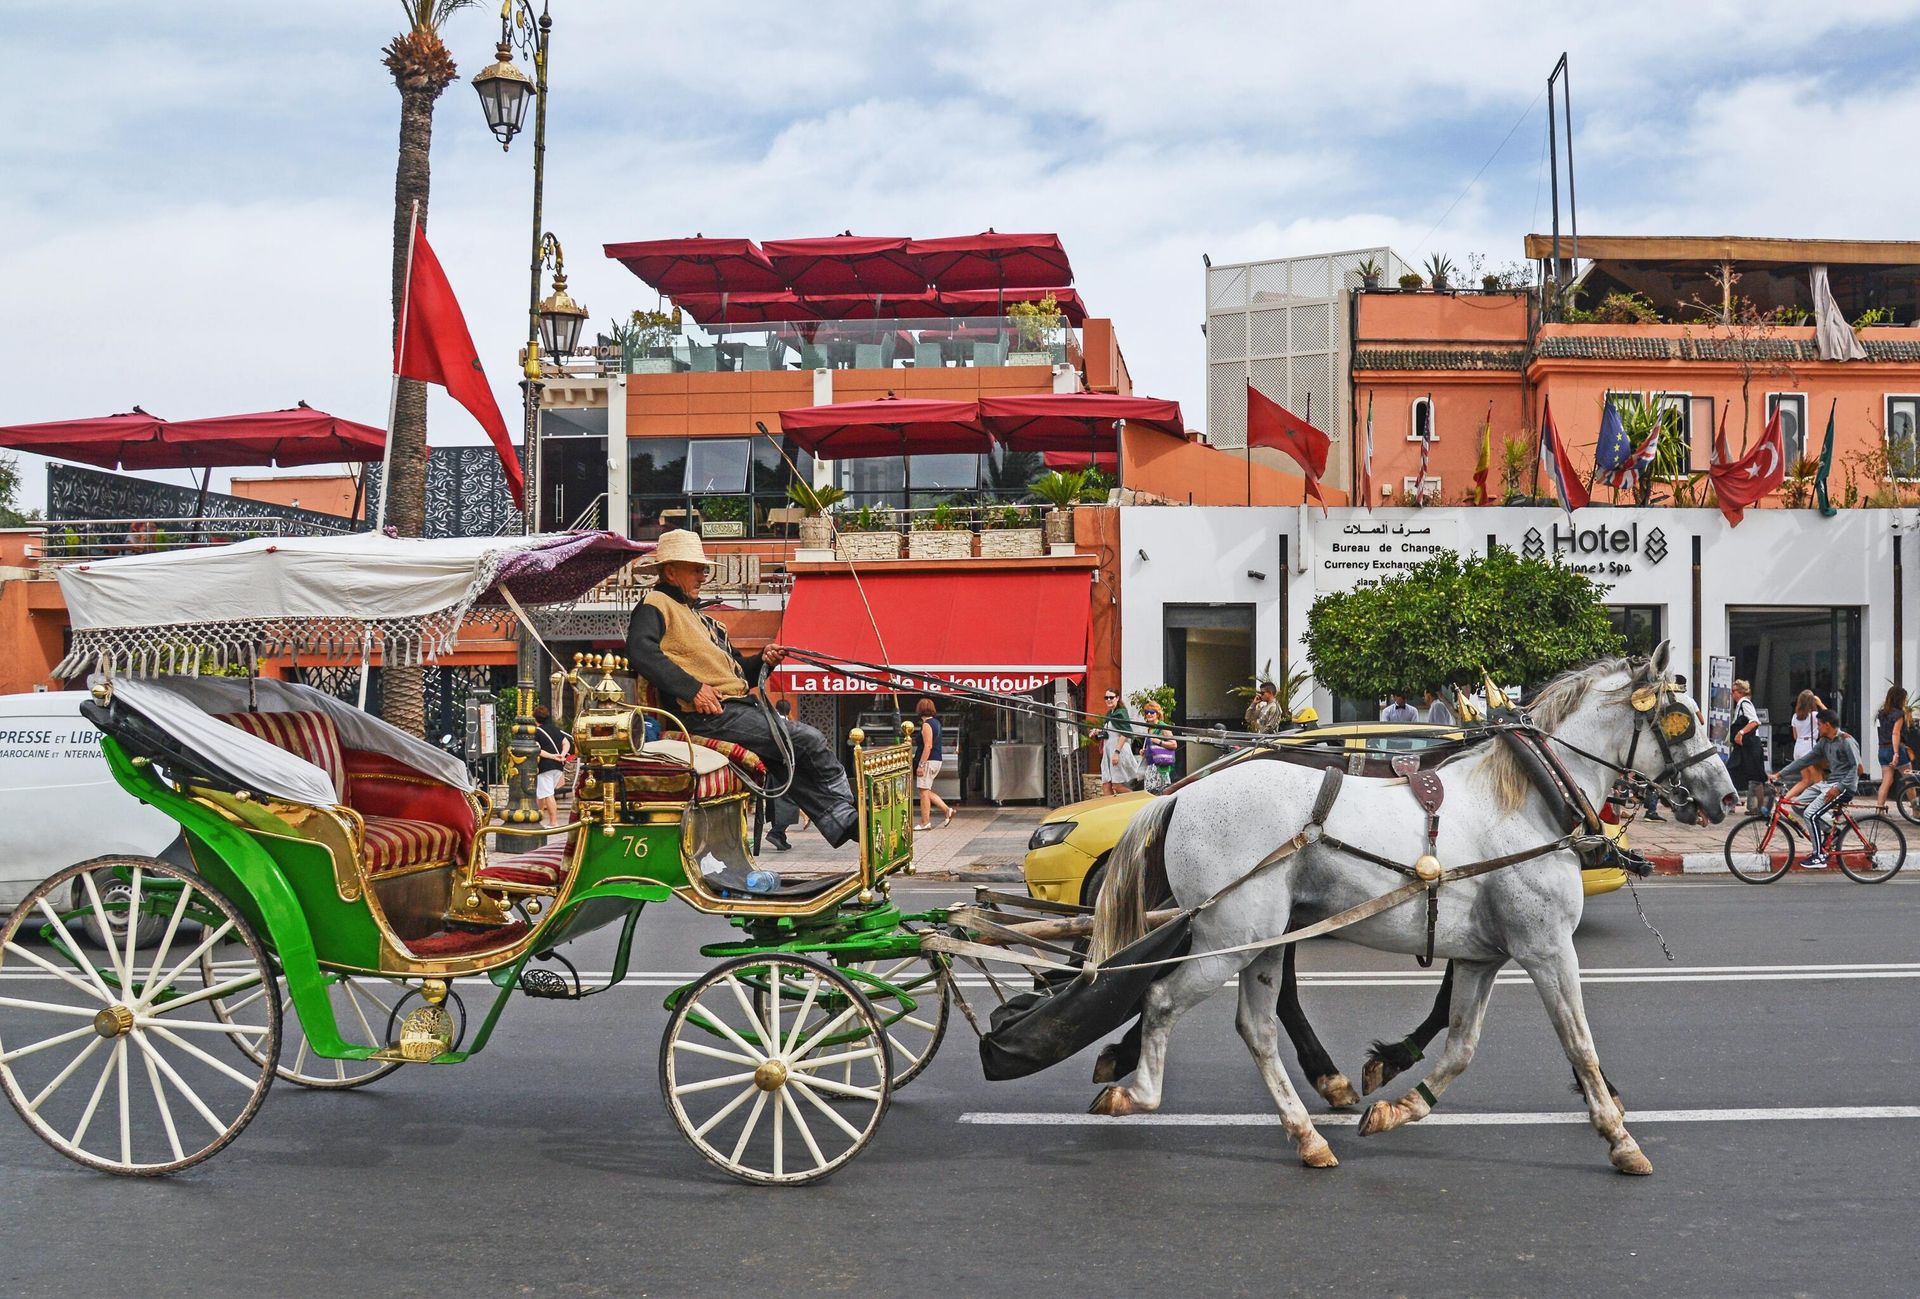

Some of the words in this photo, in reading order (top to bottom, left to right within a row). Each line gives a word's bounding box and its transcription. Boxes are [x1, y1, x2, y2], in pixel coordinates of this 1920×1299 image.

[1553, 522, 1638, 553] Hotel
[1332, 543, 1370, 552] Bureau
[1379, 543, 1392, 552] de
[1401, 543, 1441, 554] Change
[1324, 560, 1370, 570] Currency
[1372, 560, 1421, 570] Exchange
[1609, 561, 1632, 577] Spa
[791, 674, 817, 691] La
[822, 674, 878, 691] table
[923, 674, 941, 691] la
[950, 674, 1049, 691] koutoubi
[0, 731, 52, 743] PRESSE
[70, 731, 103, 743] LIBR
[622, 836, 648, 858] 76
